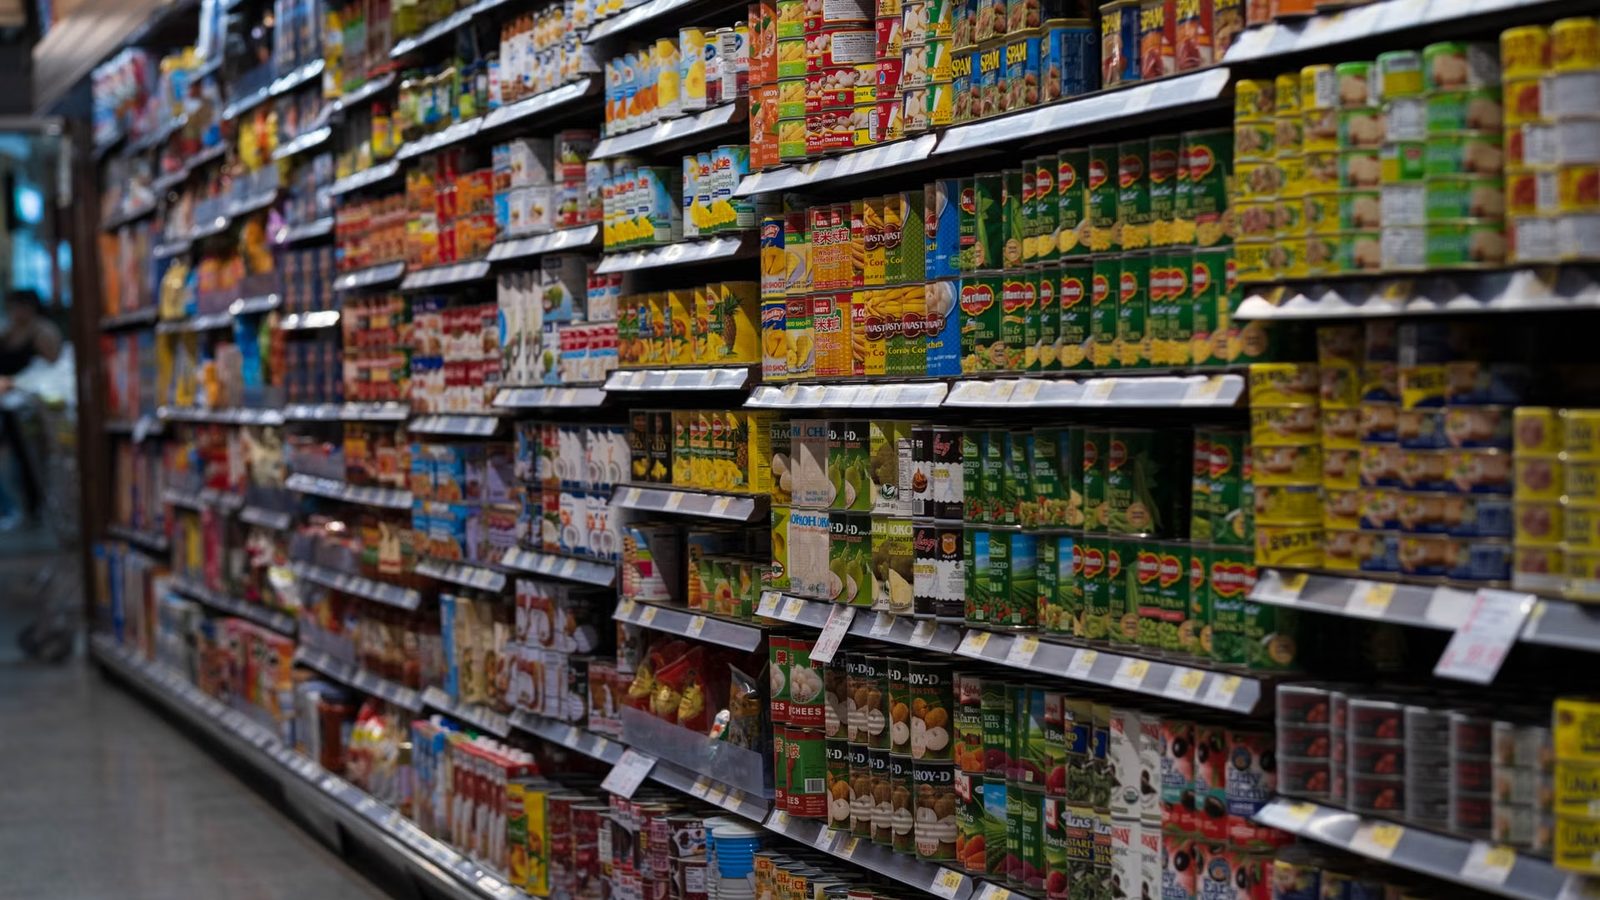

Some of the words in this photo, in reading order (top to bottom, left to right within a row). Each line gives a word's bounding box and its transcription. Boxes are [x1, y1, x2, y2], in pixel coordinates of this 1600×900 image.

[980, 49, 1000, 73] SPAM
[1007, 41, 1027, 65] SPAM
[951, 56, 972, 79] SPAM
[824, 136, 849, 144] Chestnuts
